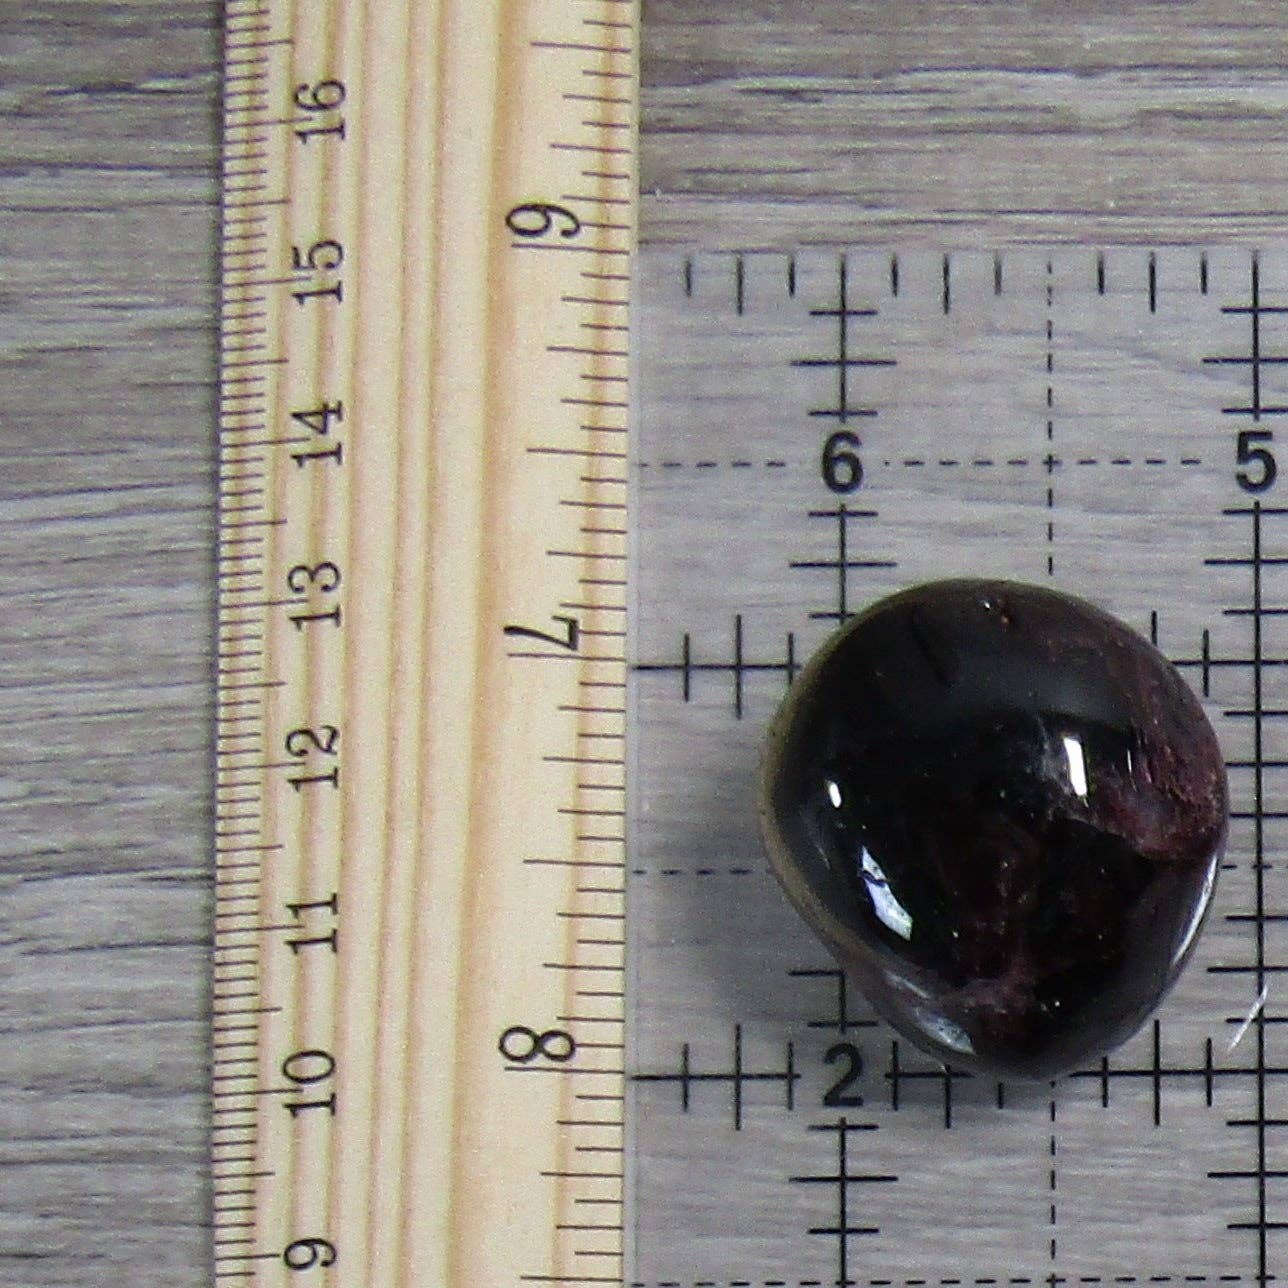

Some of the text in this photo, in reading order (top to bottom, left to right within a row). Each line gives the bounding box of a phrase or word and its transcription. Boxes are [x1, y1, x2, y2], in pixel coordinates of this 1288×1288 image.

[295, 78, 346, 143] 16
[504, 201, 580, 239] 6
[292, 238, 345, 304] 15
[290, 401, 343, 467] 14
[820, 430, 864, 495] 6
[1234, 430, 1278, 494] 5
[288, 561, 342, 627] 13
[503, 615, 581, 650] 7
[286, 725, 339, 792] 12
[288, 893, 338, 954] 11
[499, 1025, 577, 1064] 8
[822, 1043, 864, 1107] 2
[284, 1050, 335, 1114] 10
[284, 1238, 337, 1270] 9
